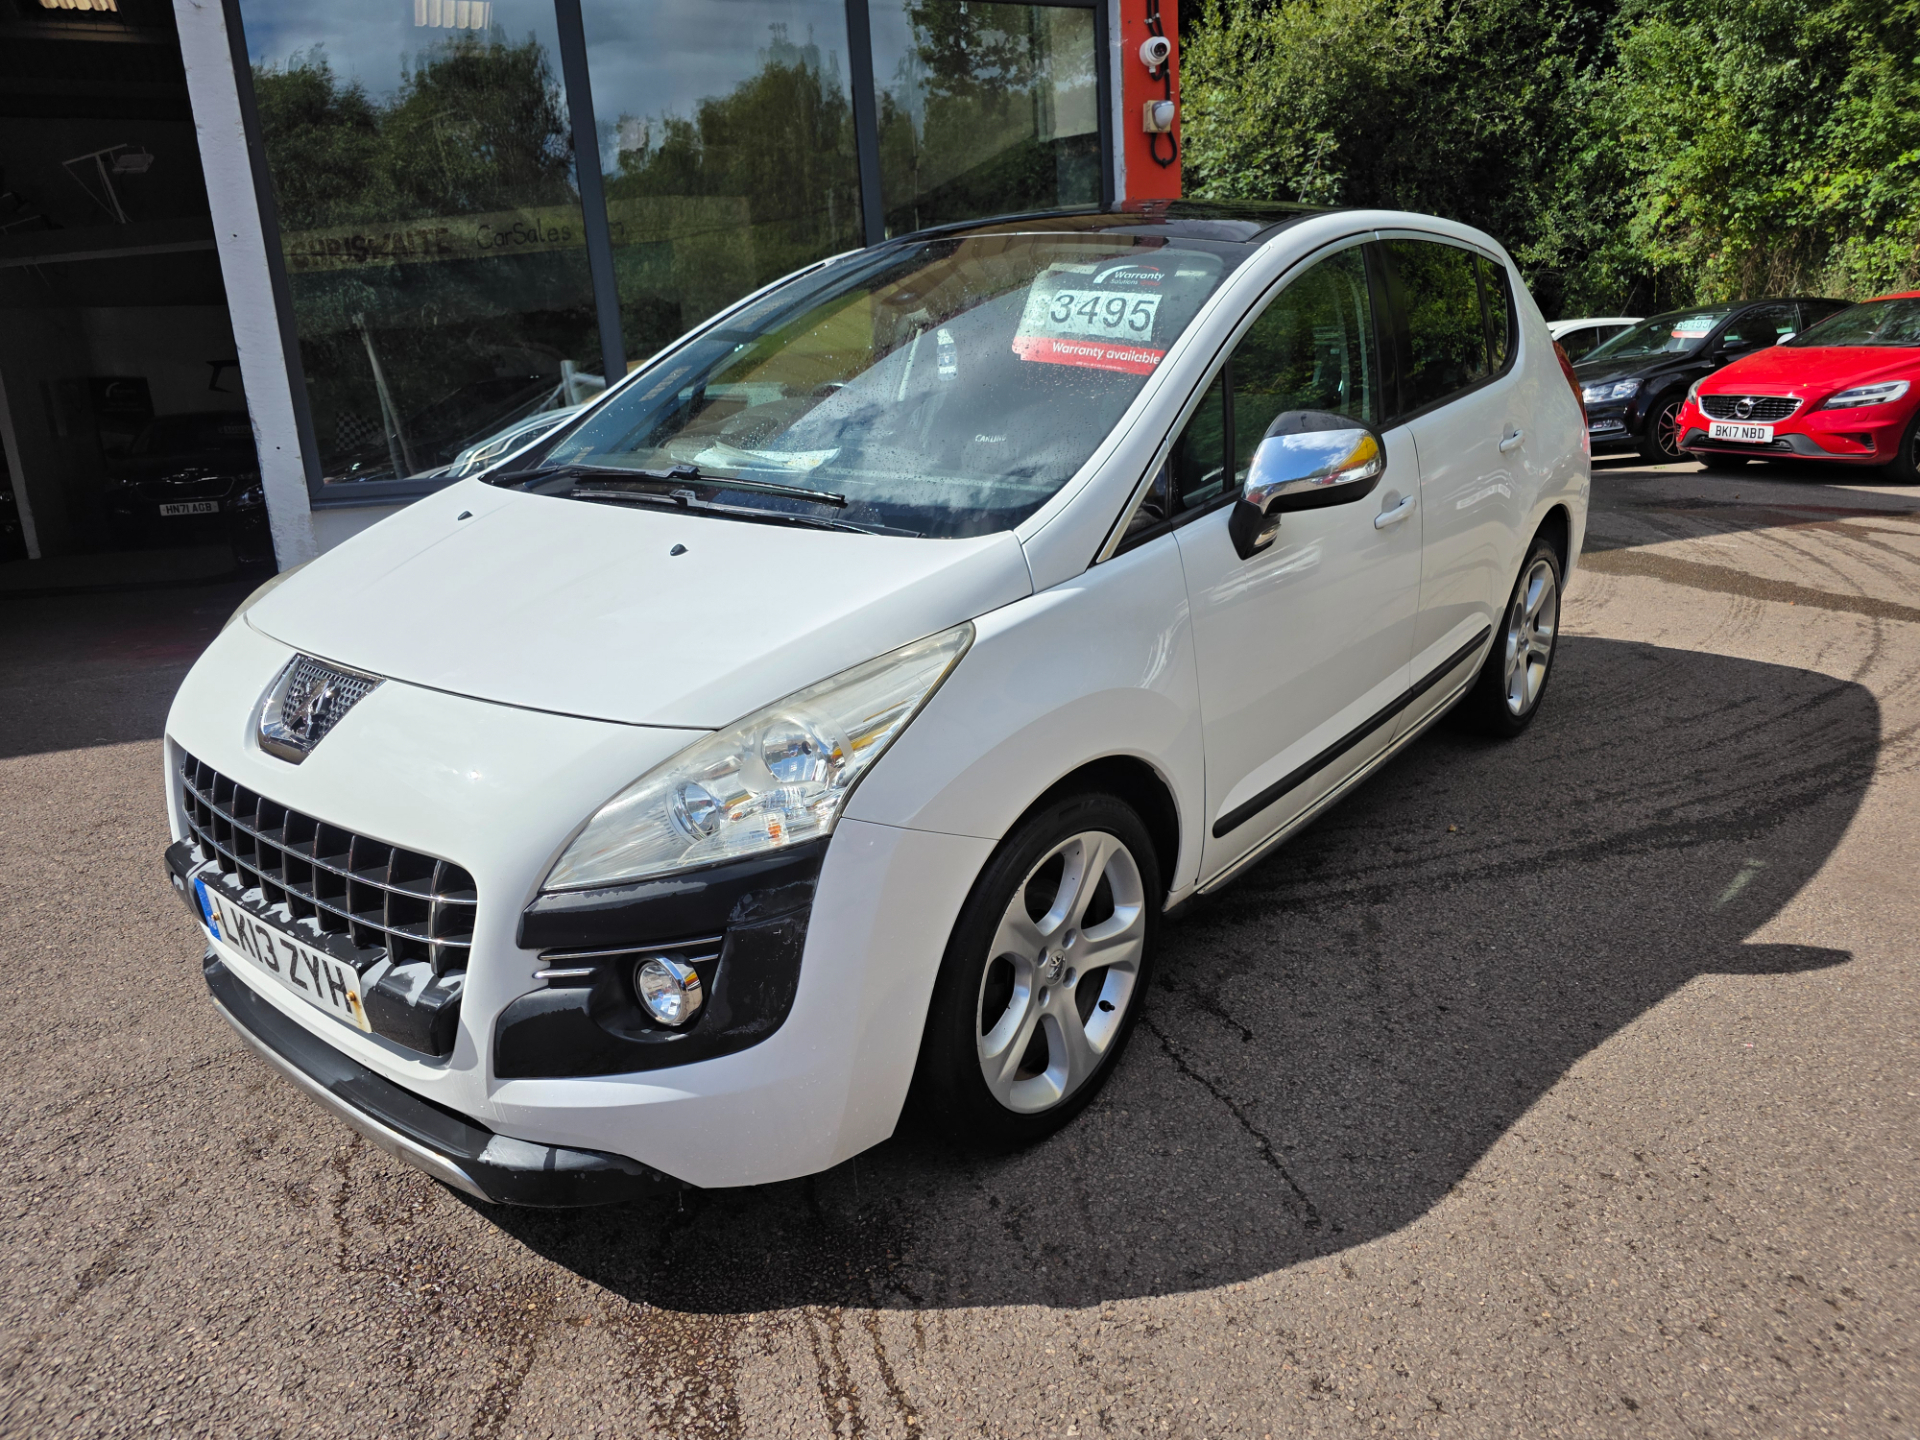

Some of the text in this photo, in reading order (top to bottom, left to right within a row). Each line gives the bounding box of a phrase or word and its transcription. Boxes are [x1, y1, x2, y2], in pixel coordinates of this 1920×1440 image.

[1114, 271, 1165, 281] Warranty
[1052, 342, 1161, 365] Warranty available
[1715, 425, 1765, 439] BK17 NBD
[166, 504, 189, 514] HN71
[215, 897, 352, 1014] LK13 ZYH
